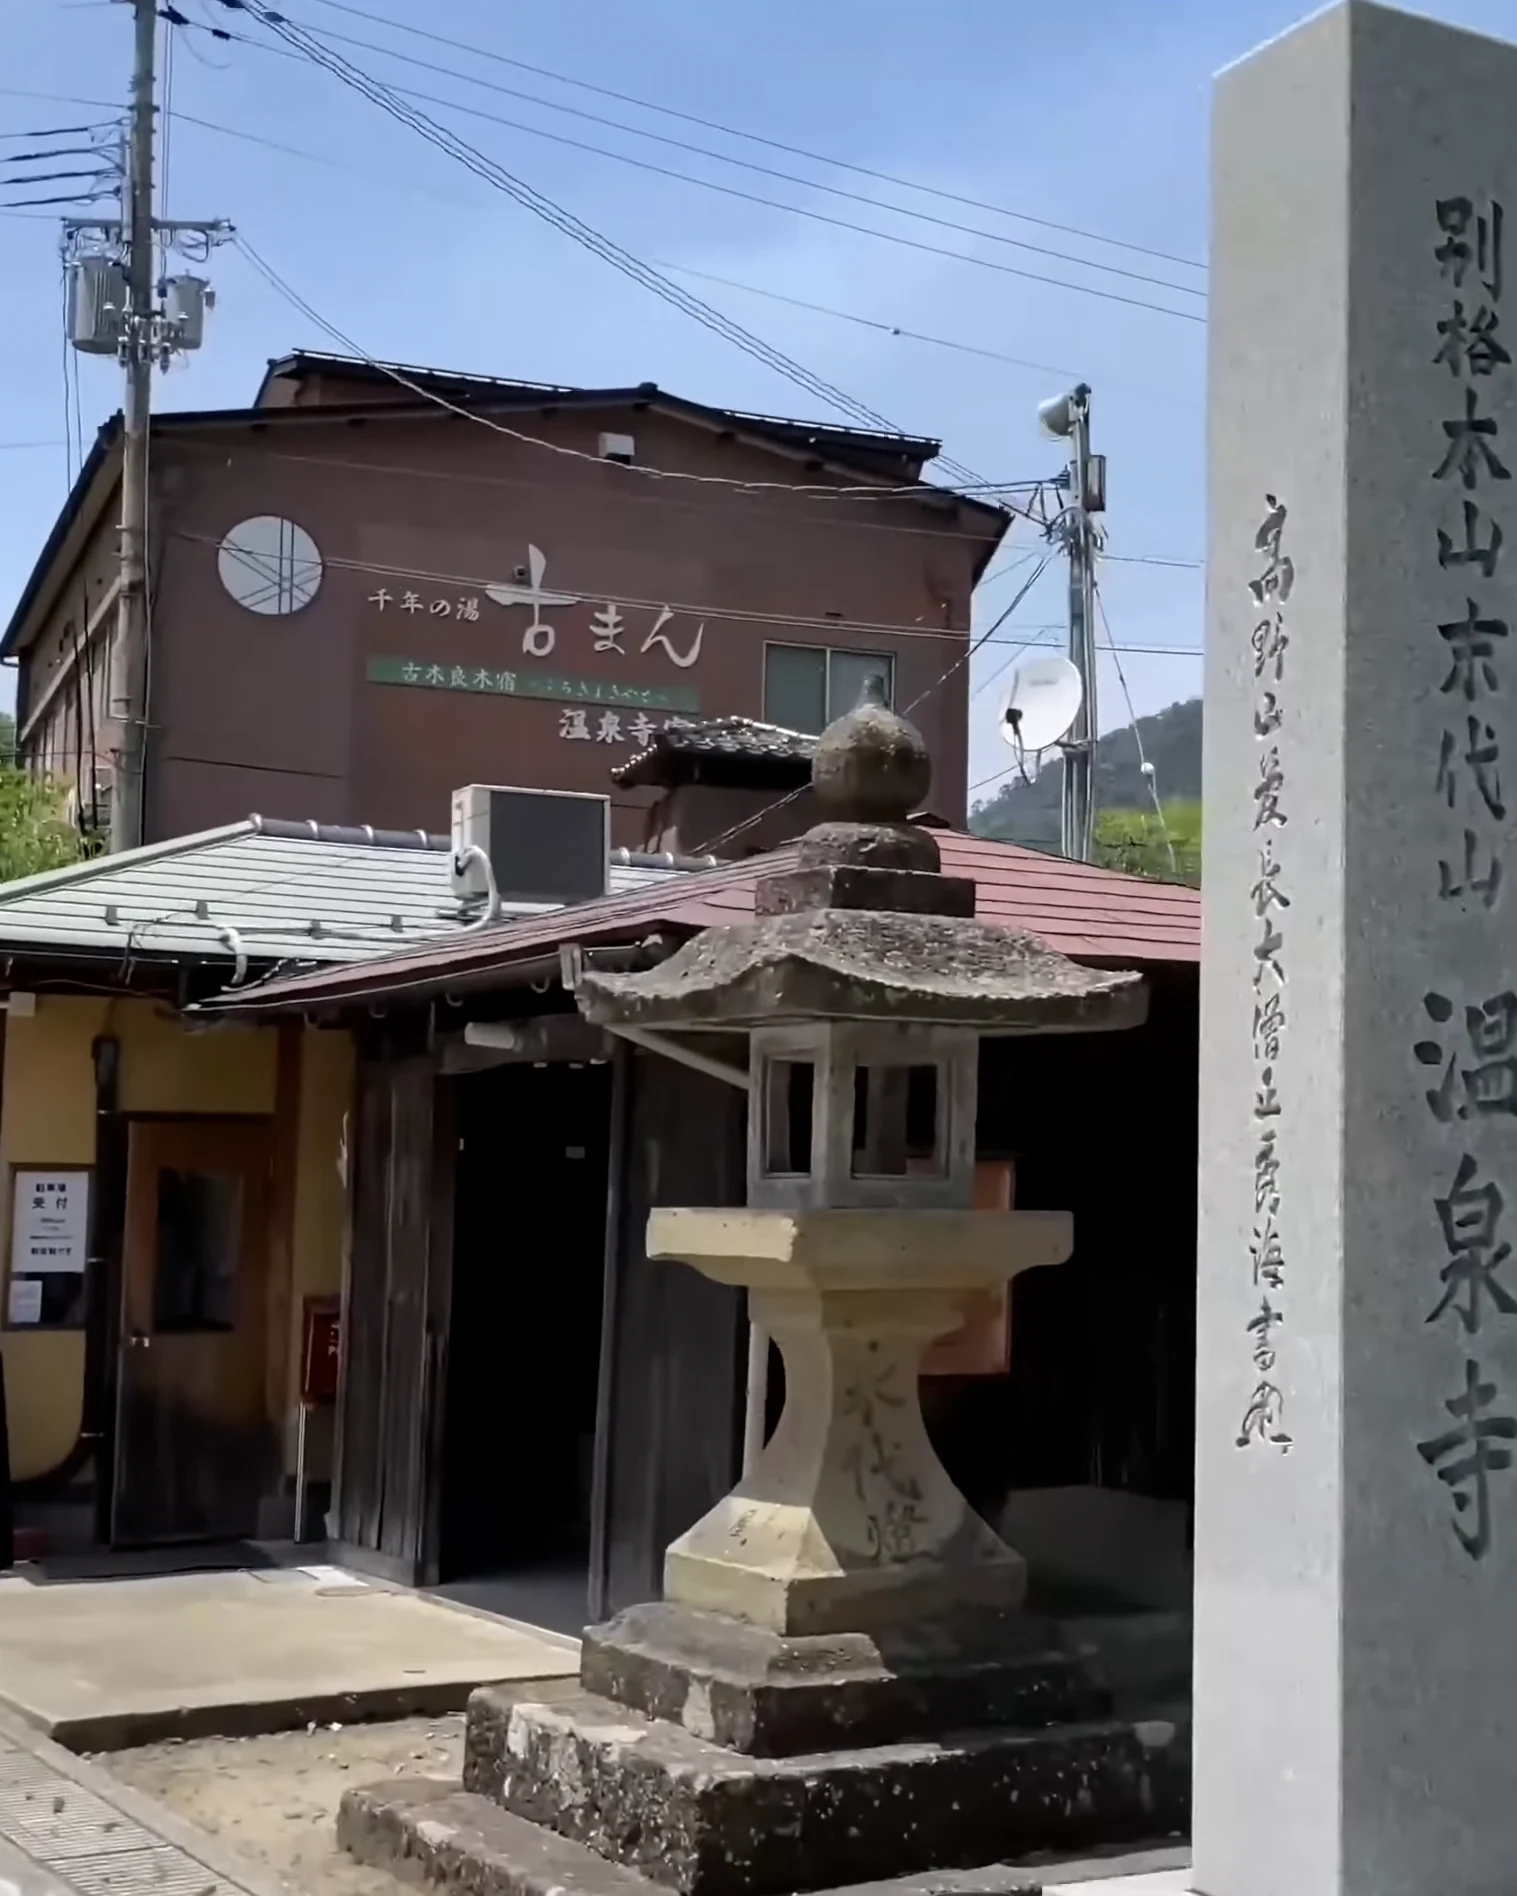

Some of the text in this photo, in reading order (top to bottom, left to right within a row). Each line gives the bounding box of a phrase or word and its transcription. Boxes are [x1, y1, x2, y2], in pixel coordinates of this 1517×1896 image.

[367, 587, 480, 623] 千年の湯
[401, 660, 518, 694] 古木良木宿
[32, 1197, 68, 1210] 受付
